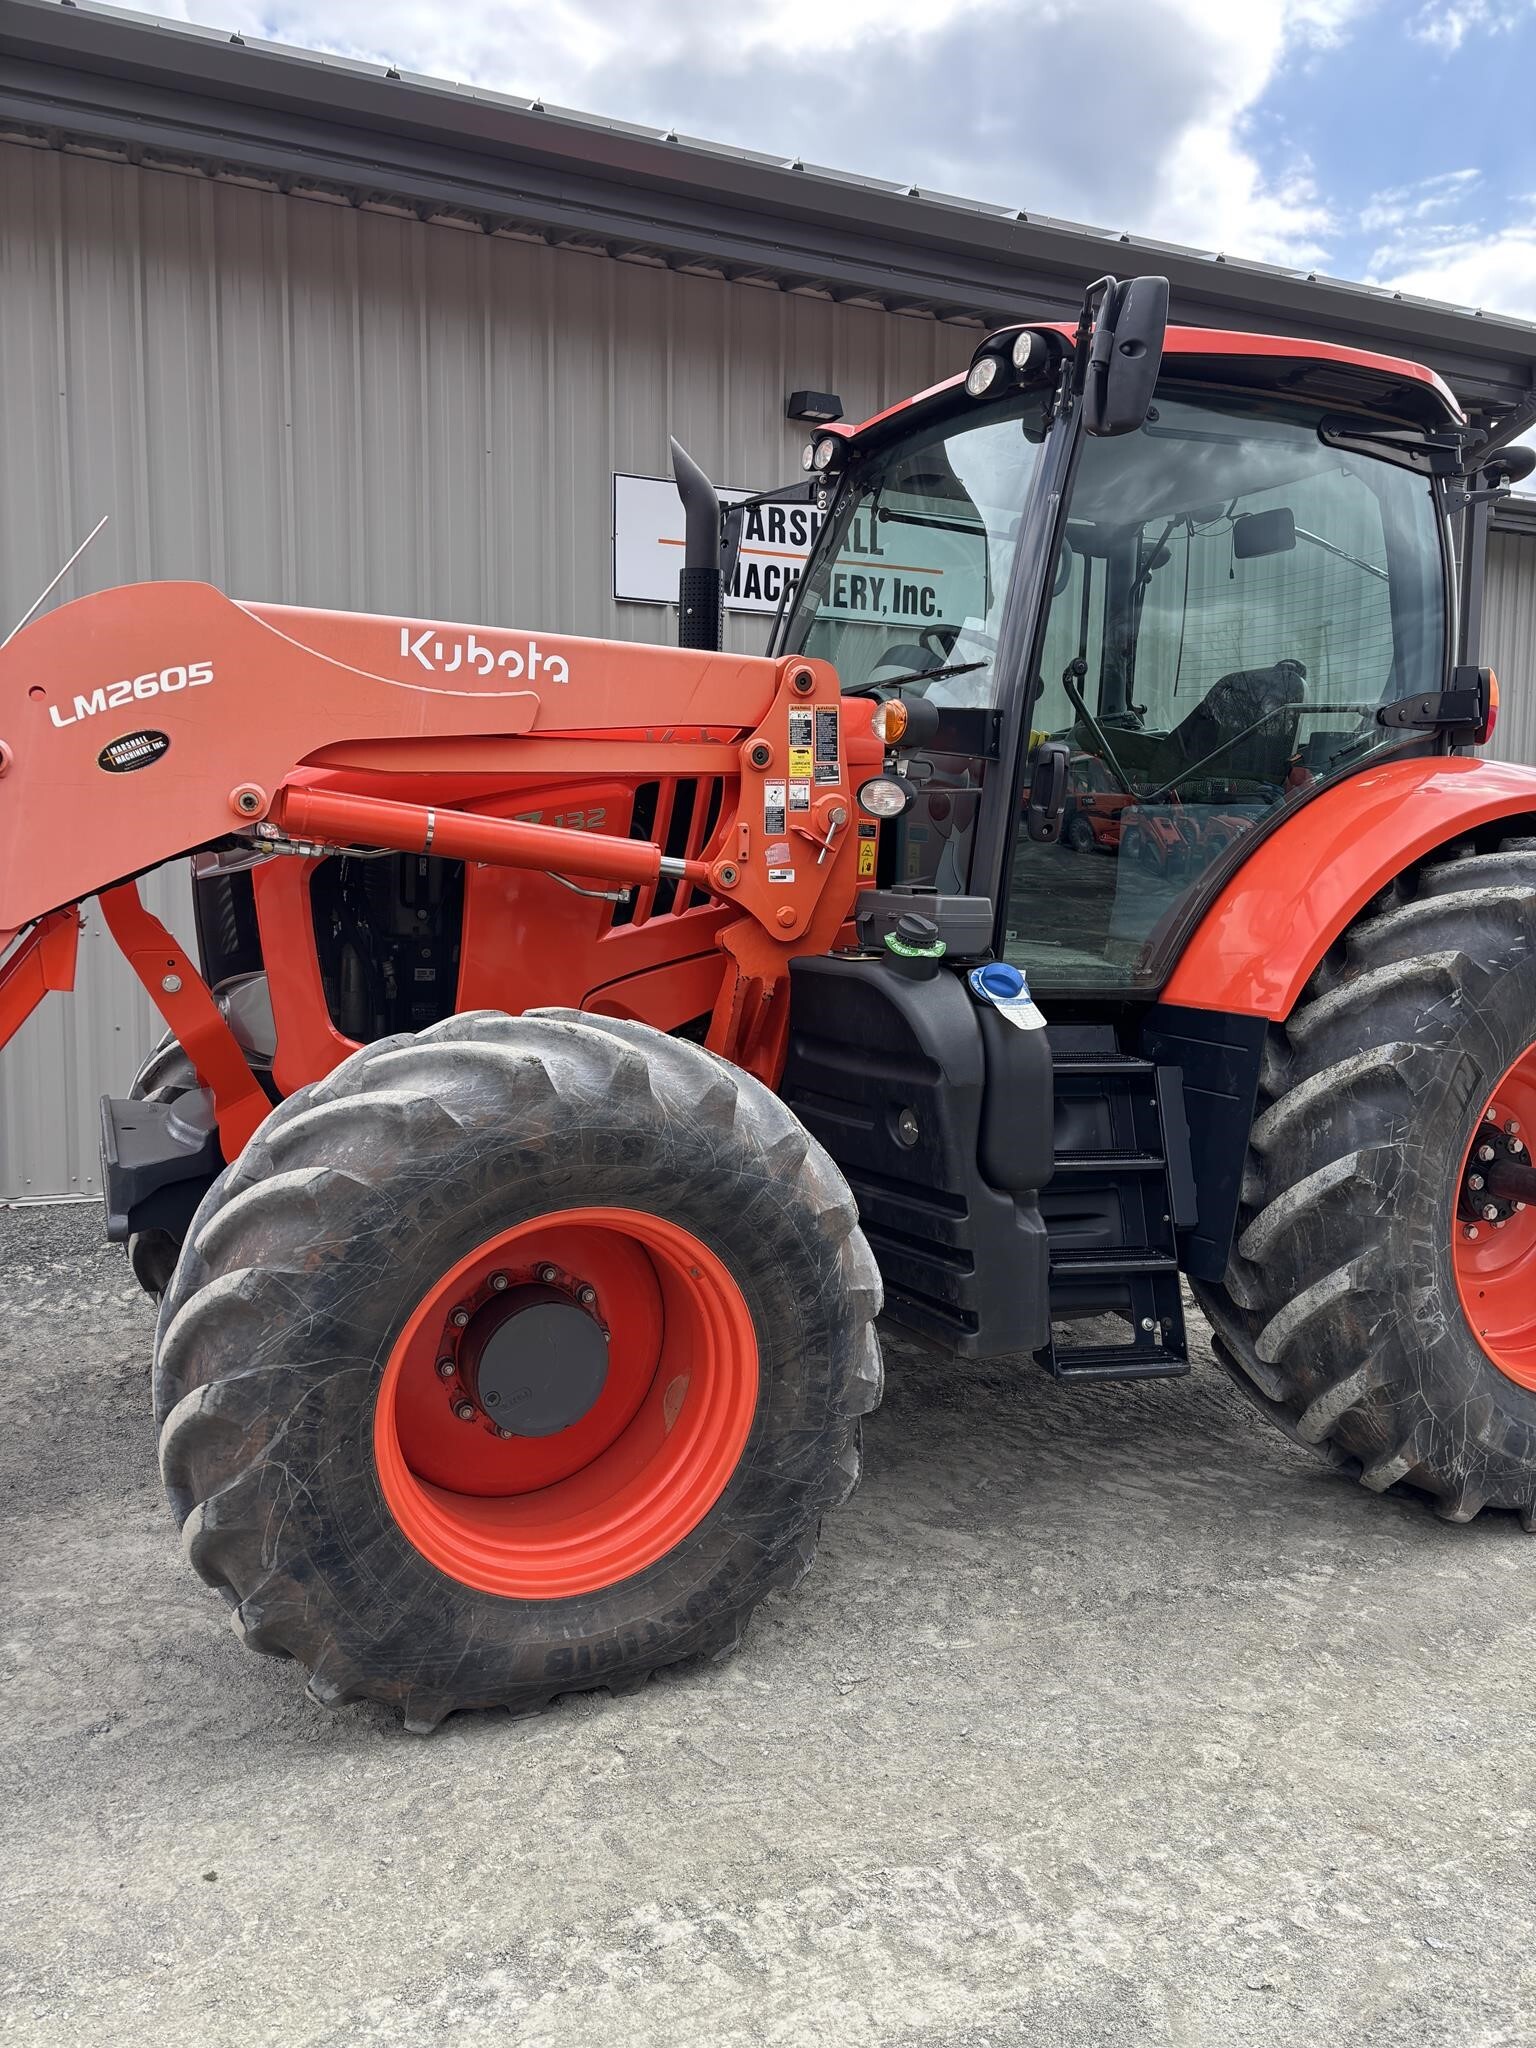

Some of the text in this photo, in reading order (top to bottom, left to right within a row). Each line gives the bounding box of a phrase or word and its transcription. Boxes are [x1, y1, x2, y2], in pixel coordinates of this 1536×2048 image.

[893, 578, 942, 617] Inc.
[400, 627, 569, 684] Kubota
[49, 661, 214, 728] LM2605
[110, 735, 149, 755] MARSHALL
